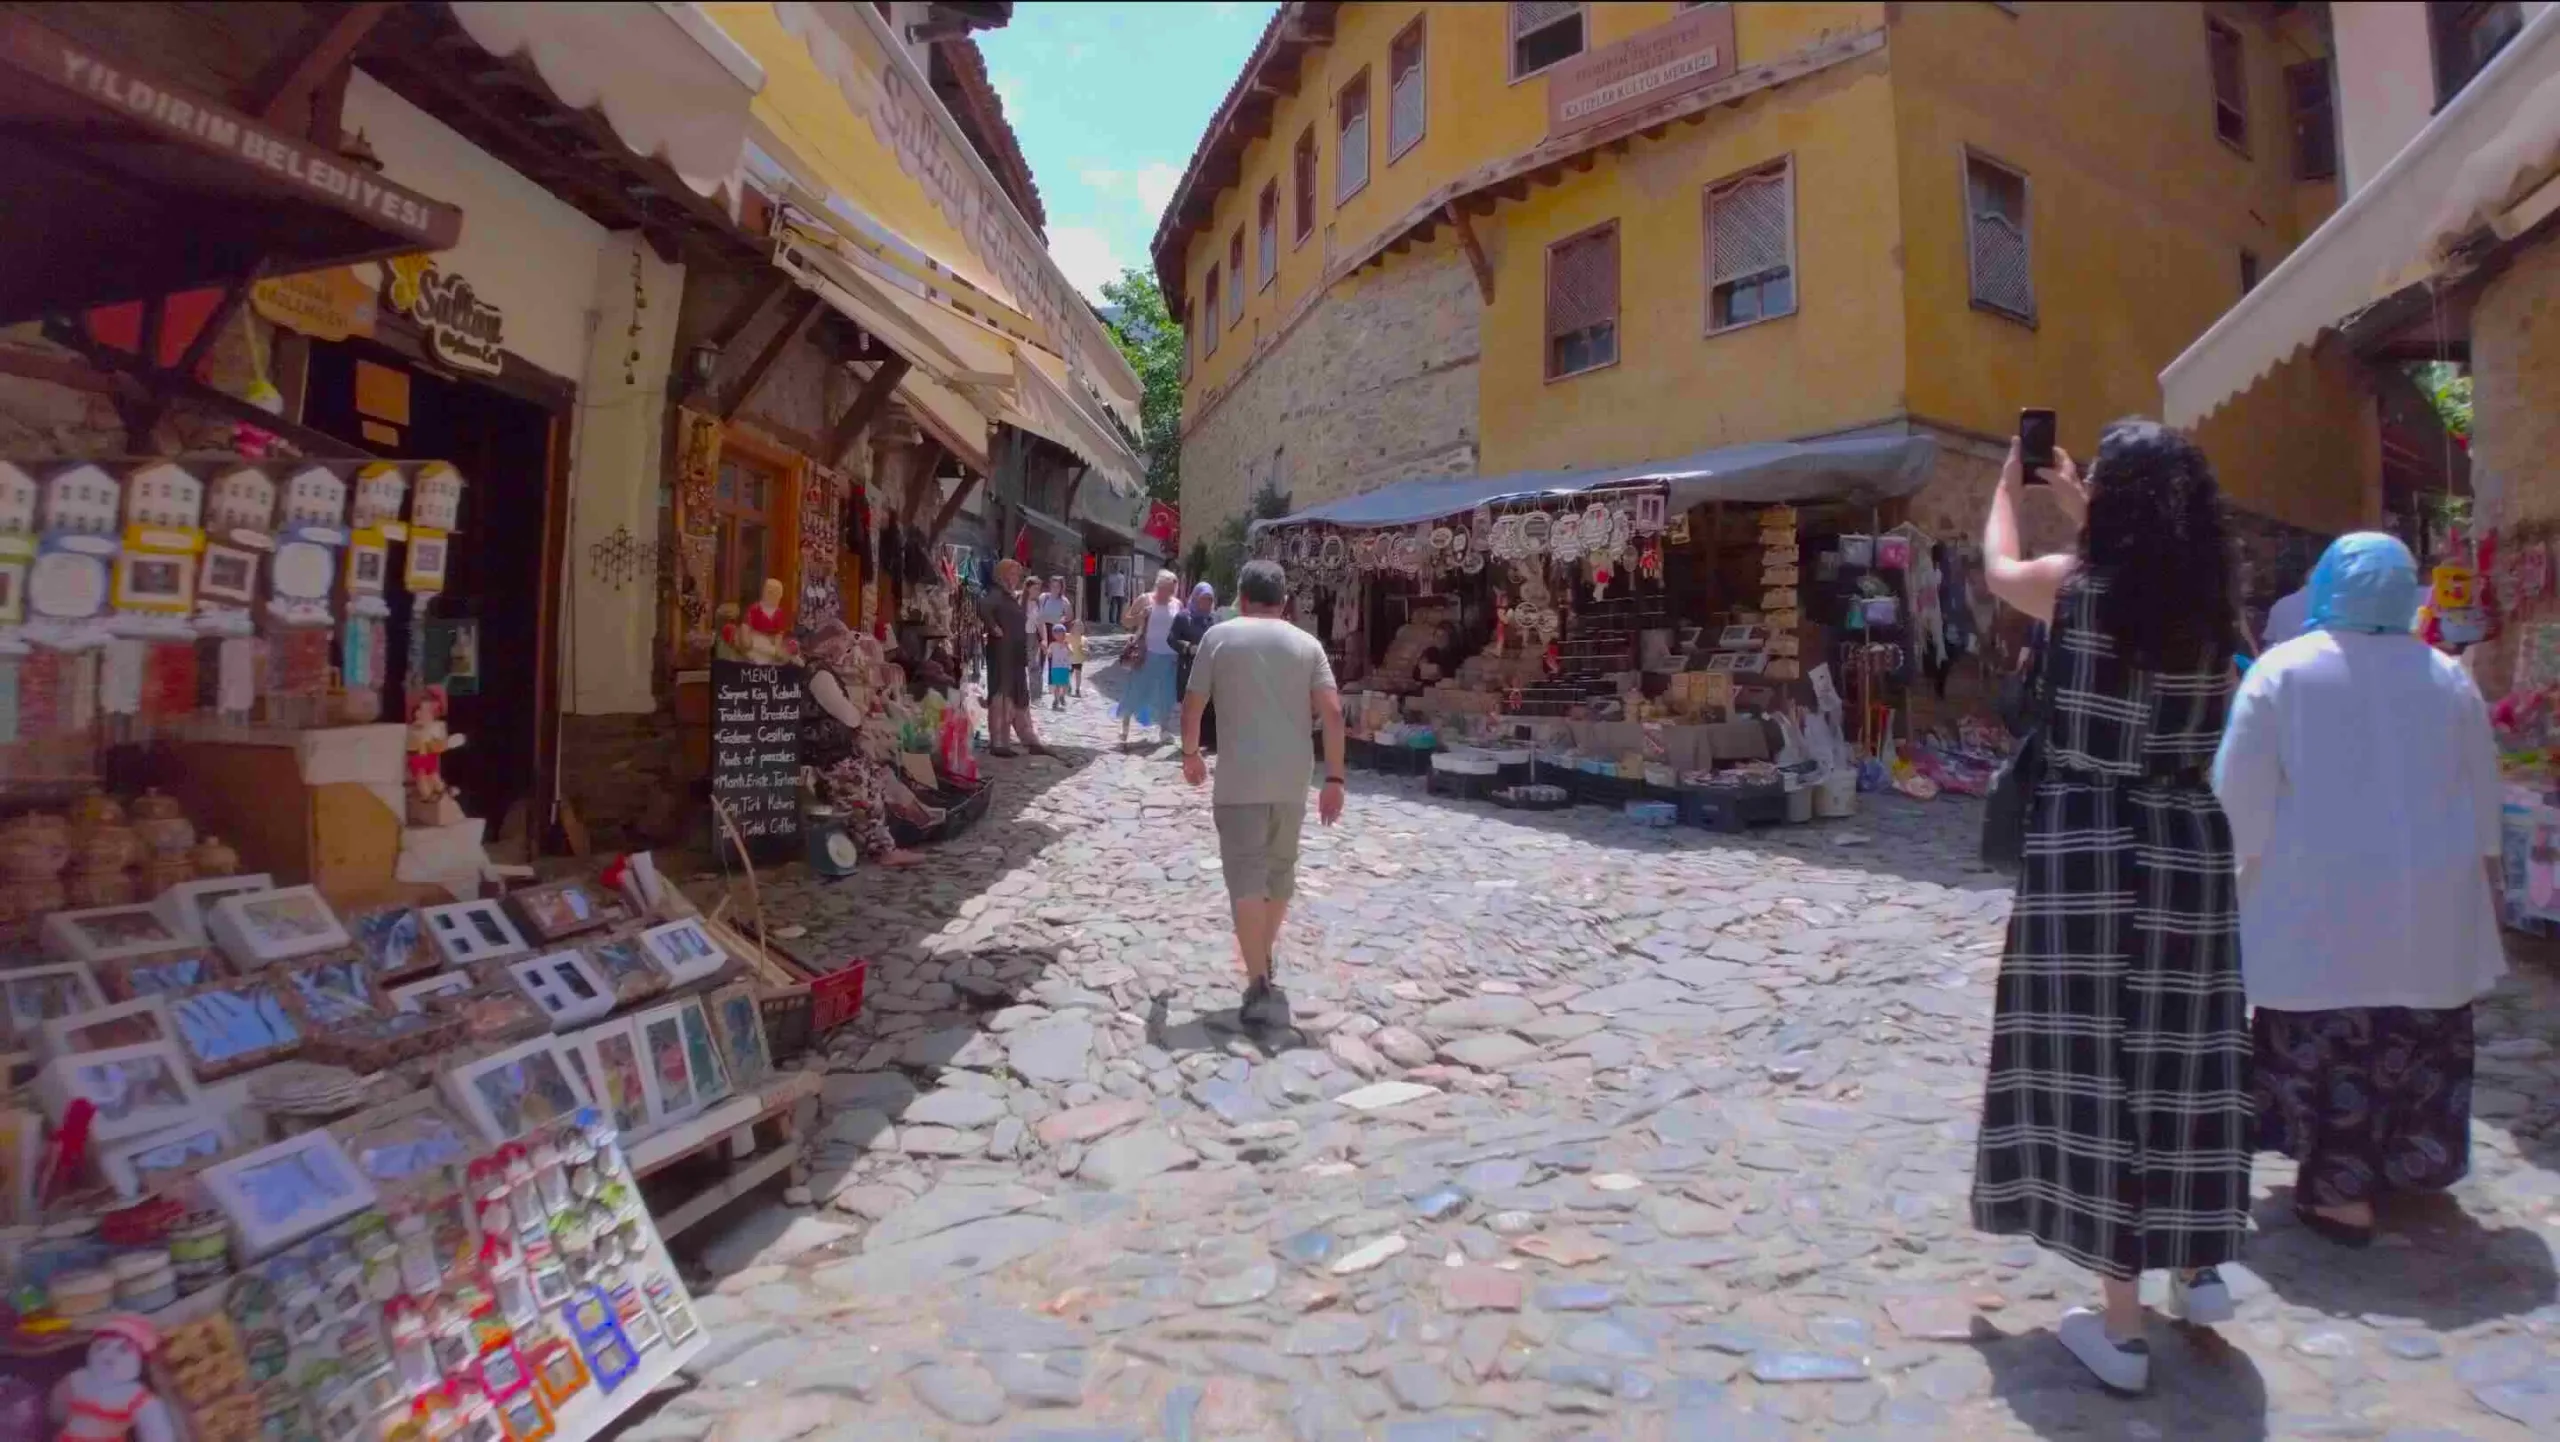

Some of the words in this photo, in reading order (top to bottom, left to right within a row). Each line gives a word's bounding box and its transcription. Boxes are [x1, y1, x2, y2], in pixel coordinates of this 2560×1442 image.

[61, 49, 239, 148] YILDIRIM
[240, 129, 430, 231] BELEDİYESİ
[879, 63, 970, 220] Sultan
[415, 268, 503, 344] Sultan
[740, 666, 779, 684] MENÜ
[743, 747, 756, 766] of
